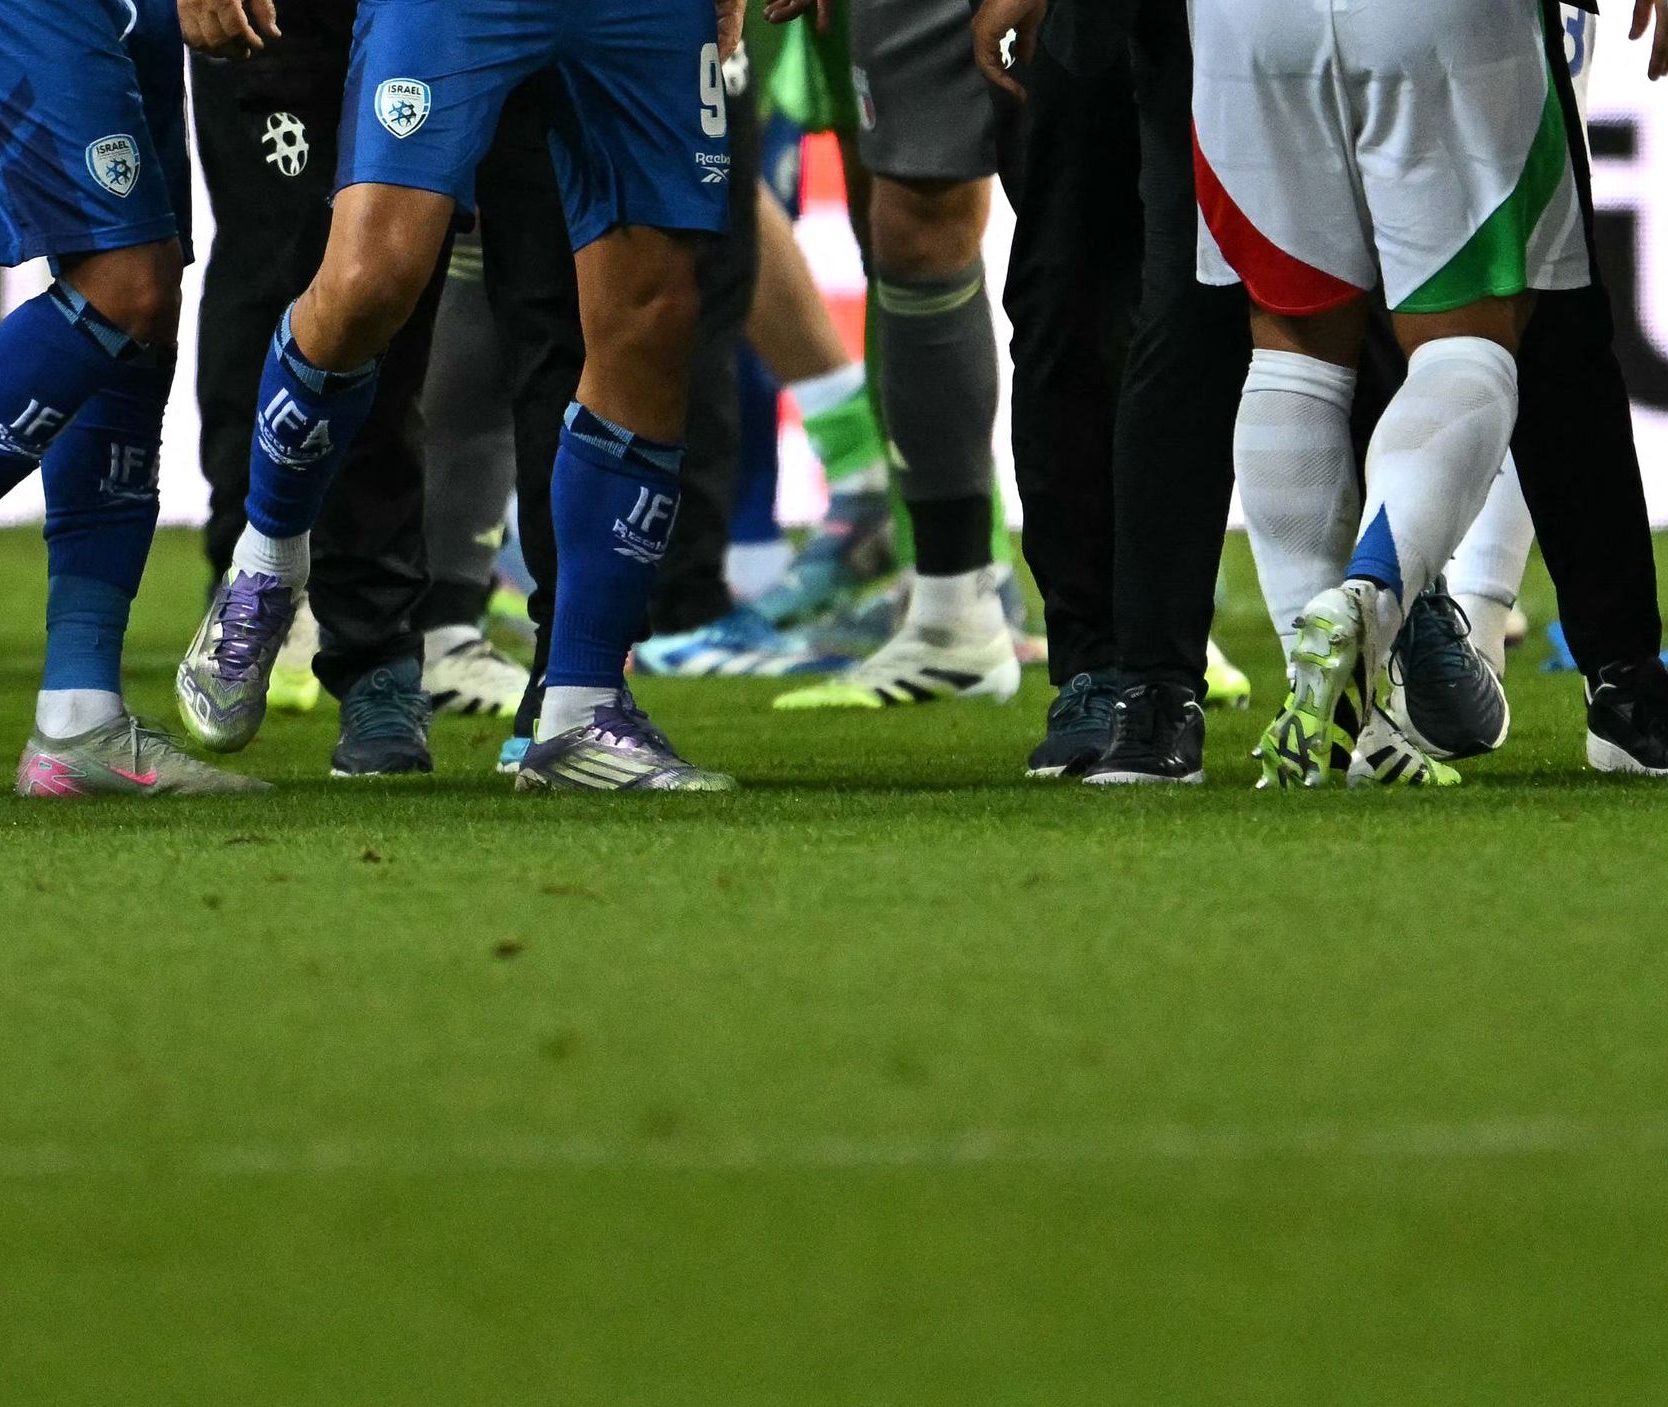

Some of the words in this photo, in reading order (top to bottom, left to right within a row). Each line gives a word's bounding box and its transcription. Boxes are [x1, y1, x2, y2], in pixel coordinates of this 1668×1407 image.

[388, 85, 421, 95] ISRAEL
[700, 43, 727, 138] 9
[97, 141, 130, 154] ISRAEL
[10, 399, 64, 436] IF
